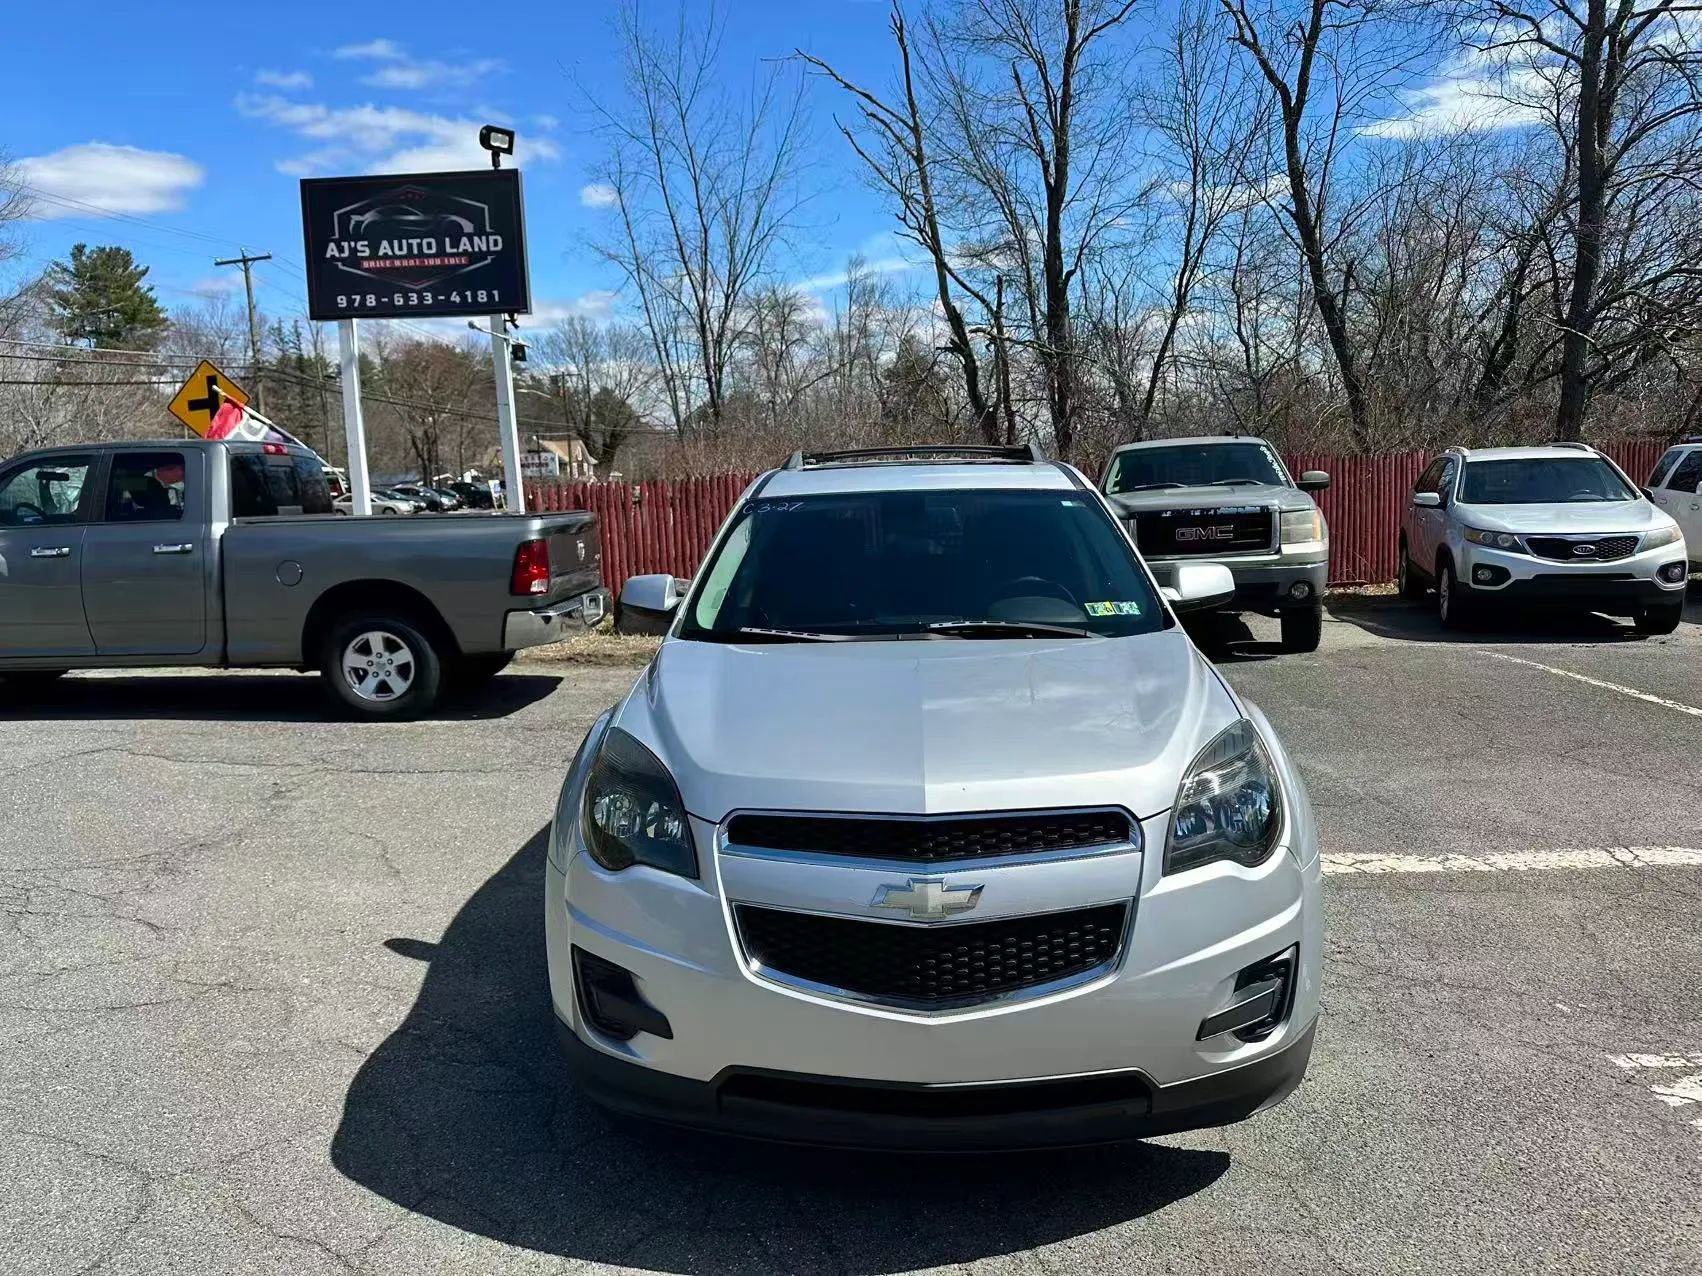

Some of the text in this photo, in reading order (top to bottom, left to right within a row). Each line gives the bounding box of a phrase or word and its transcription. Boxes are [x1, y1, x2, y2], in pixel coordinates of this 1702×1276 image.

[325, 235, 503, 258] AJ'S AUTO LAND
[336, 290, 500, 308] 978-633-4181
[1175, 525, 1234, 541] GMC
